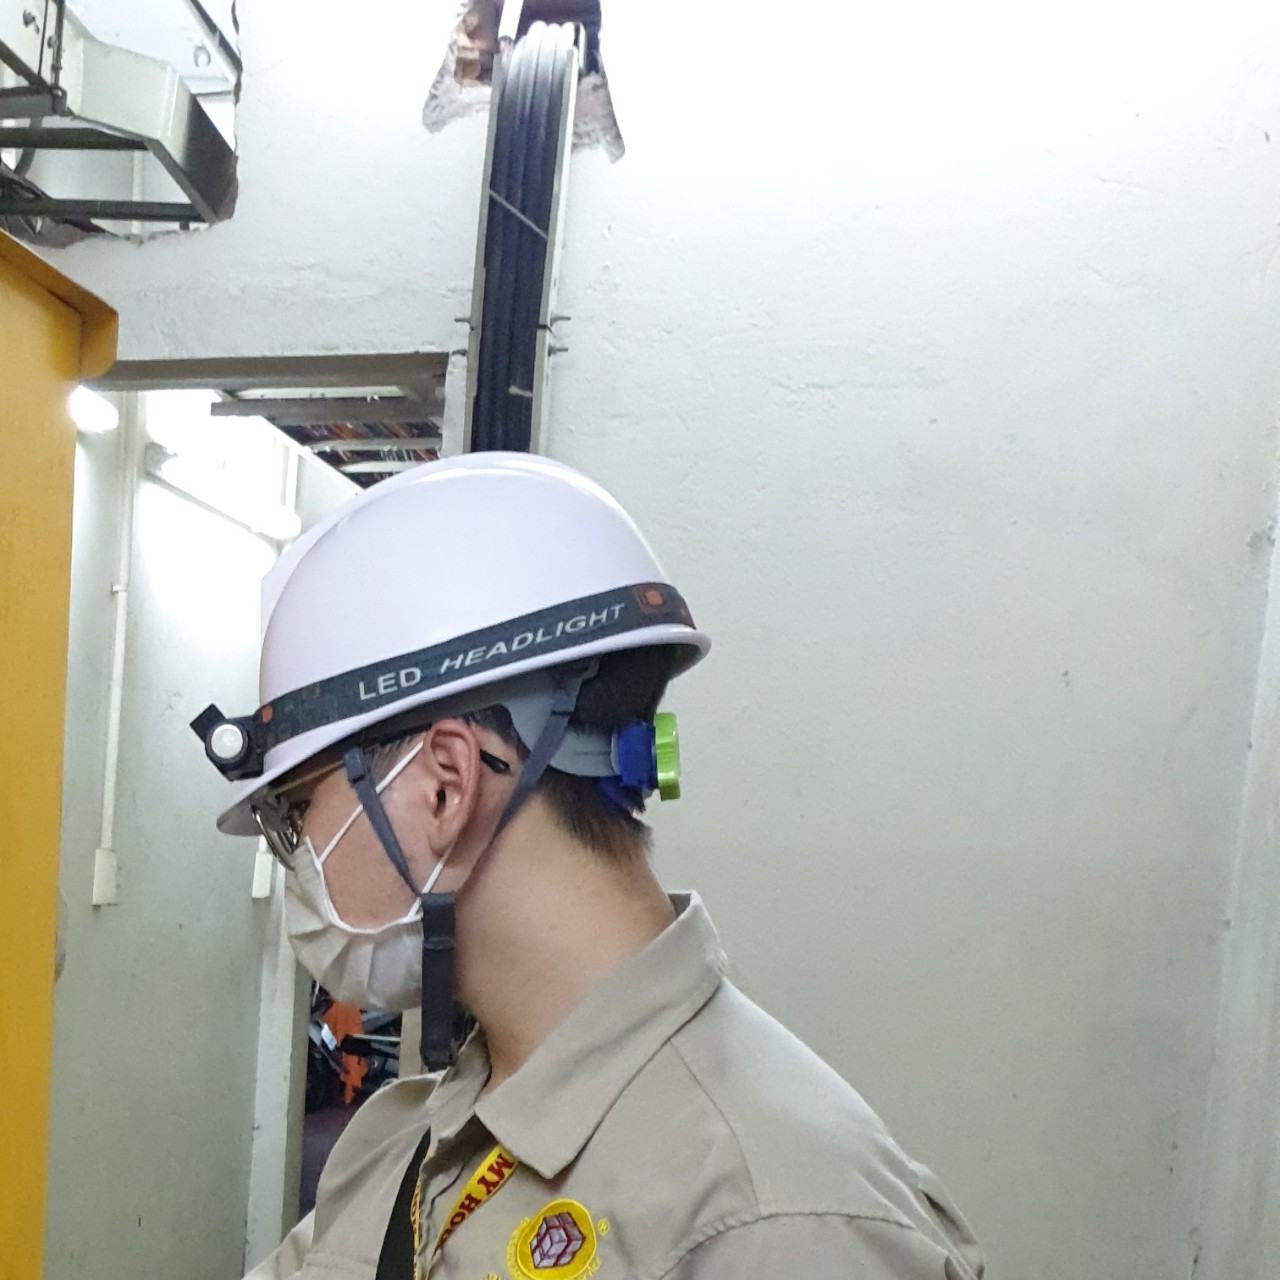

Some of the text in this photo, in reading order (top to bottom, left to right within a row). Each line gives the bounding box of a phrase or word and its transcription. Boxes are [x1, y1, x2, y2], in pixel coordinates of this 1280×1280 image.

[358, 602, 626, 701] LED HEADLIGHT
[477, 1152, 516, 1196] MY
